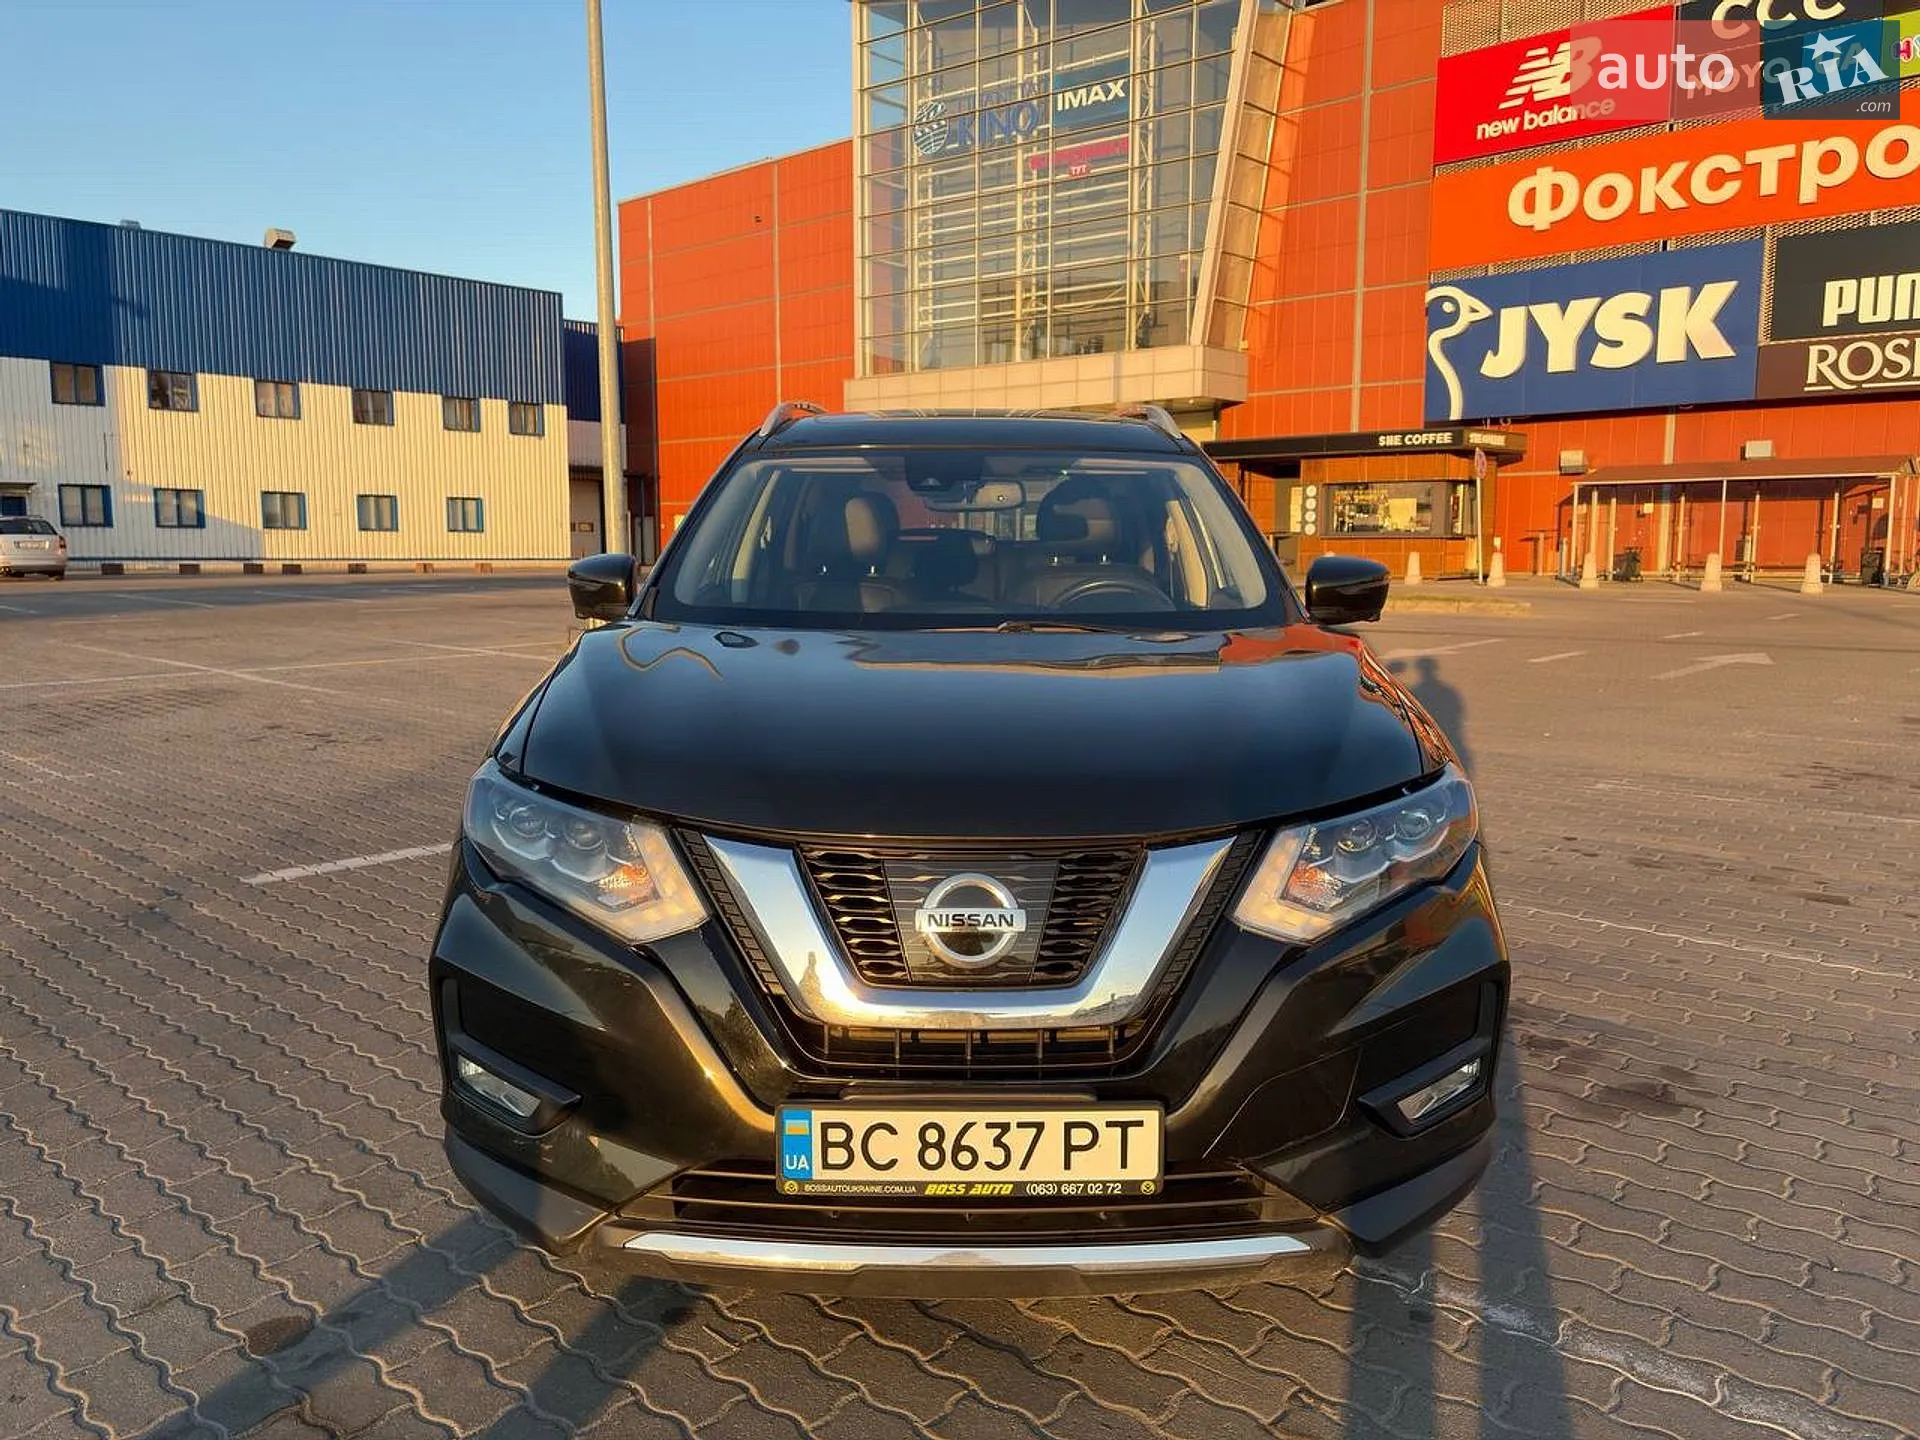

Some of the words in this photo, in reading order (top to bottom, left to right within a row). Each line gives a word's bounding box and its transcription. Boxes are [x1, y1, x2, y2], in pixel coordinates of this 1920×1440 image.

[1057, 79, 1126, 111] IMAX
[1476, 117, 1521, 140] new
[1523, 98, 1616, 131] balance
[1507, 124, 1920, 232] Фокстро
[1480, 280, 1739, 379] JYSK
[1805, 337, 1920, 391] ROS
[1404, 432, 1453, 446] COFFEE
[927, 913, 1014, 927] NISSAN
[785, 1154, 810, 1170] UA
[820, 1122, 898, 1171] BC
[917, 1121, 1045, 1171] 8637
[1063, 1121, 1144, 1171] PT
[924, 1183, 966, 1195] BOSS
[969, 1183, 1014, 1195] AUTO
[1025, 1183, 1058, 1195] (063)
[1061, 1183, 1083, 1194] 667
[1087, 1183, 1103, 1194] 02
[1106, 1183, 1122, 1194] 72
